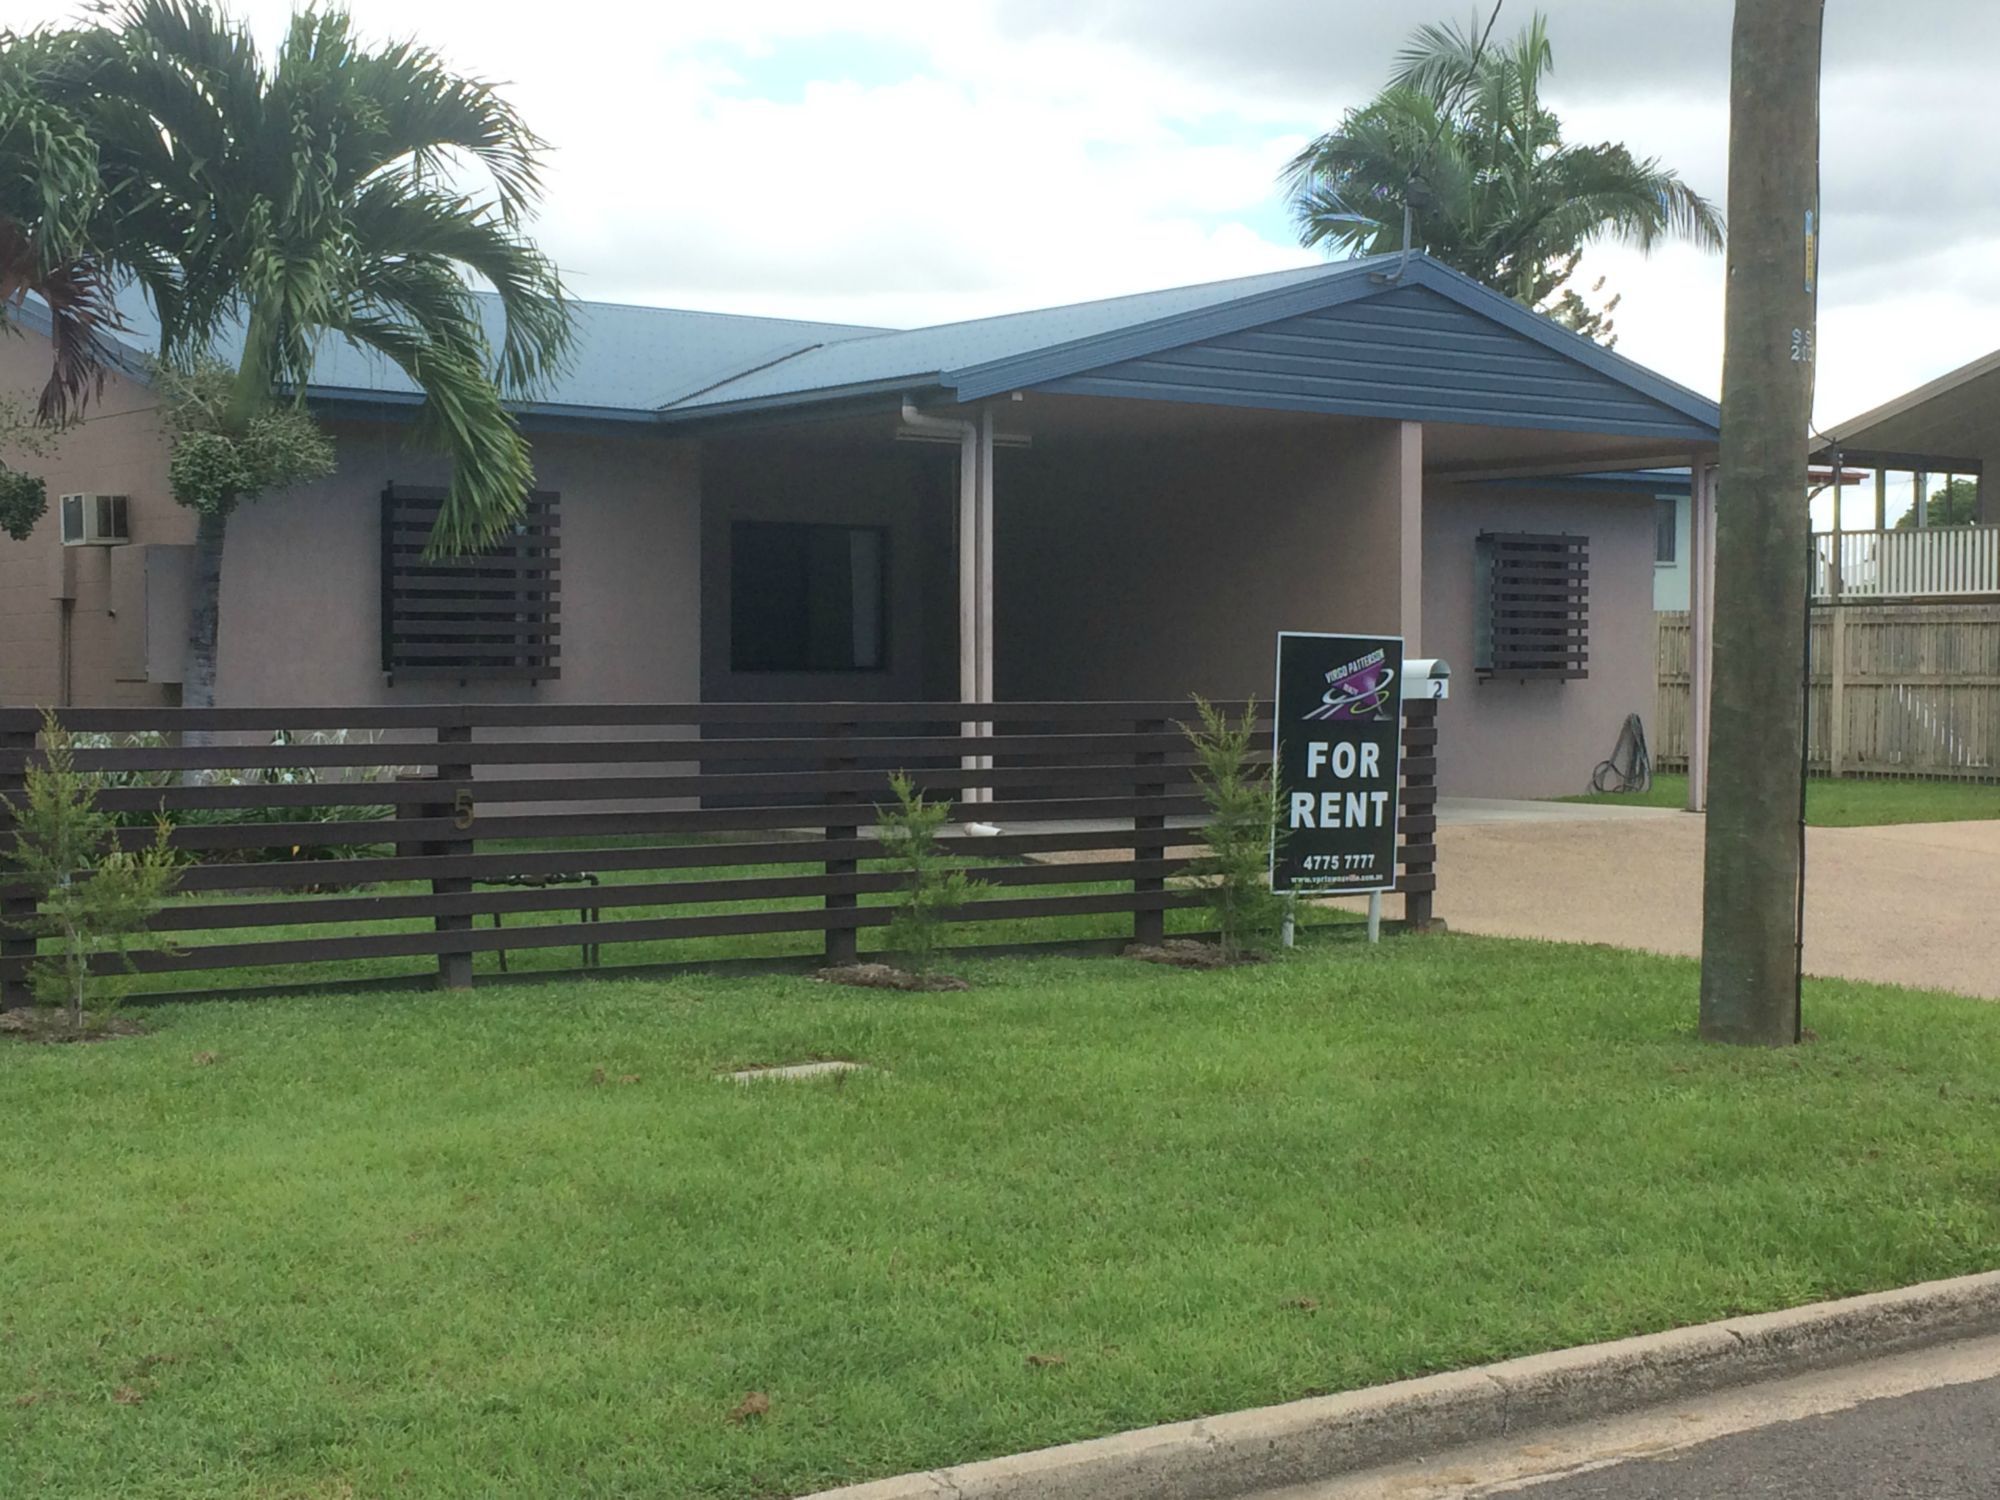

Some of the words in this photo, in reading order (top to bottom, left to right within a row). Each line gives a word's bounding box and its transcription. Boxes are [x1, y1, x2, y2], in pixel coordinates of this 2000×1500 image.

[1325, 665, 1348, 684] VIRGO
[1348, 648, 1385, 674] PATTERSON
[1433, 680, 1443, 698] 2
[1307, 741, 1380, 779] FOR
[455, 789, 474, 829] 5
[1290, 791, 1389, 828] RENT
[1303, 855, 1339, 870] 4775
[1344, 854, 1375, 869] 7777
